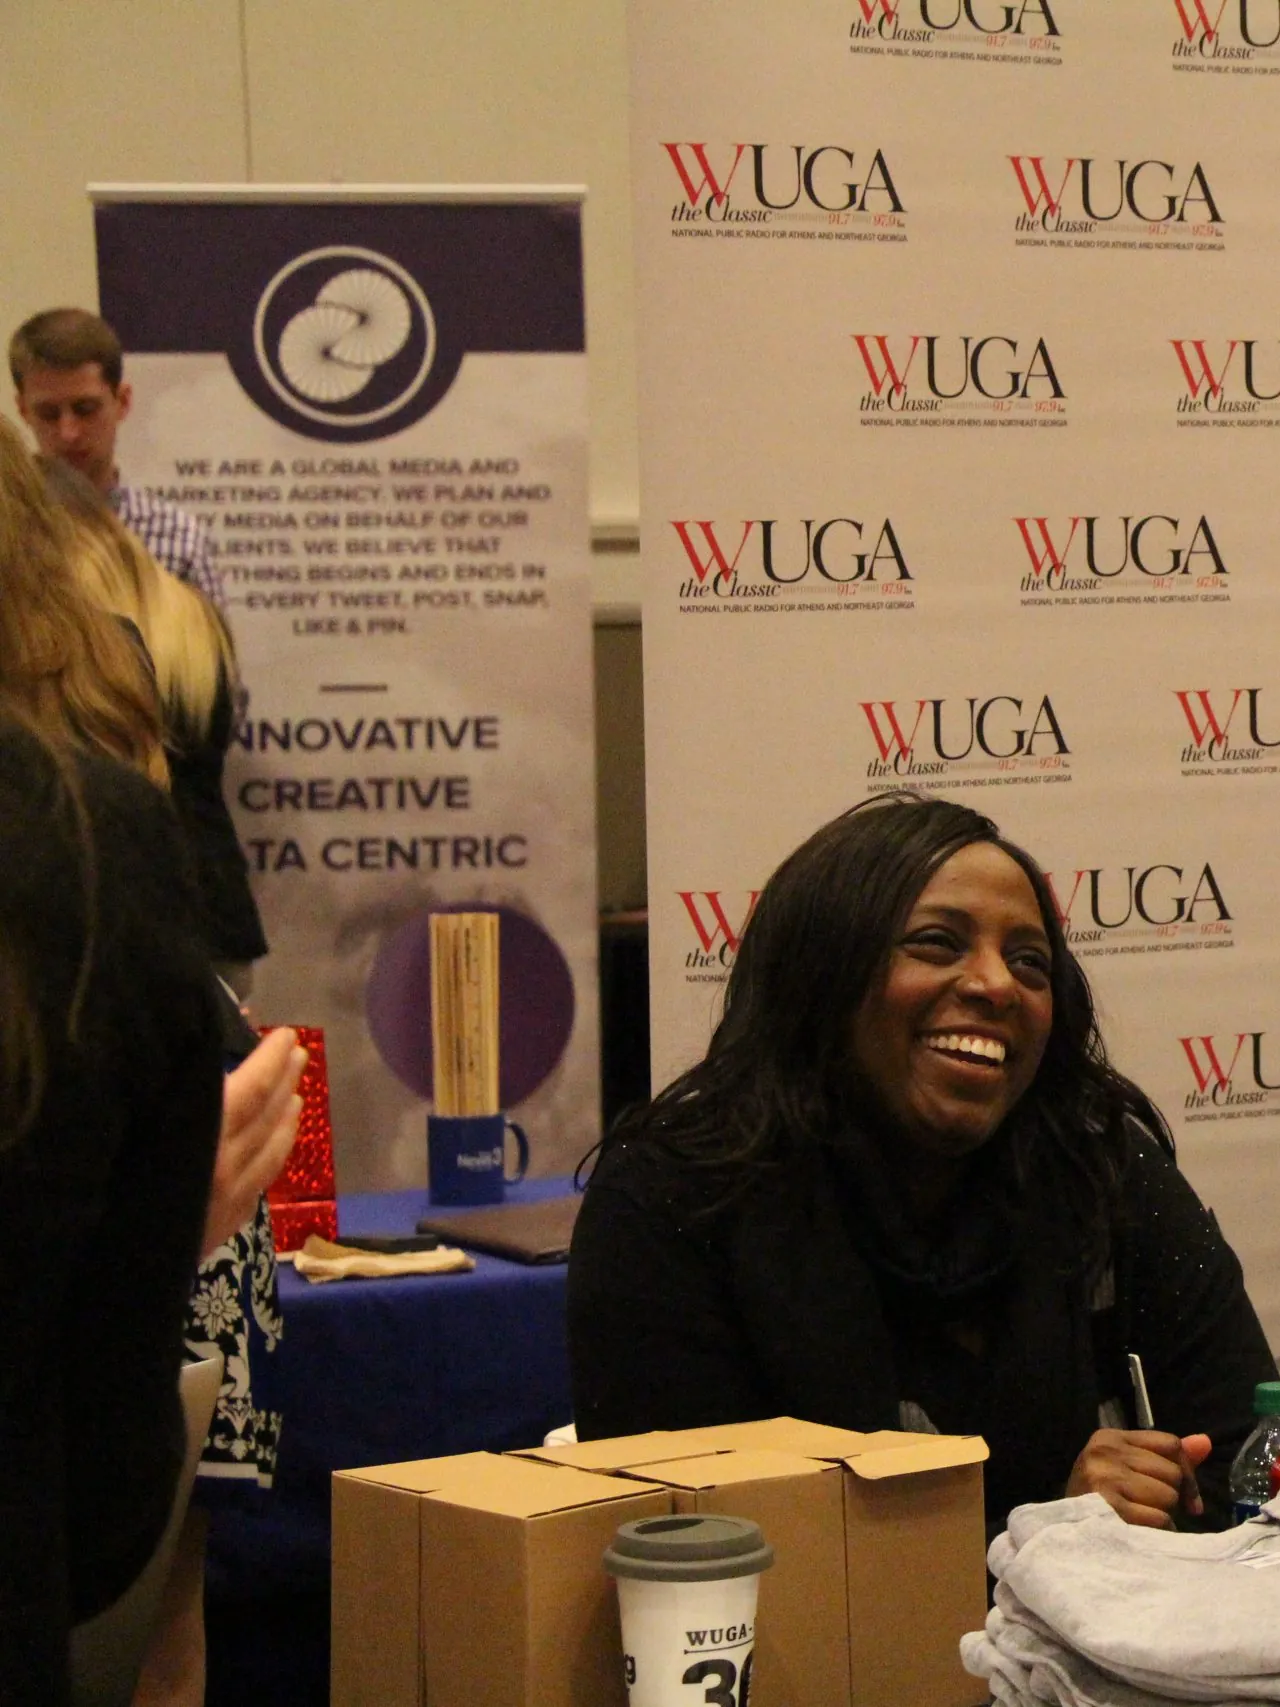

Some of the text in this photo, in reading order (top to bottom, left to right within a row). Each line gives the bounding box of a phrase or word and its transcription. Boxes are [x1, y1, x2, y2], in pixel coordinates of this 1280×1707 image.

[850, 18, 876, 39] the
[878, 12, 935, 43] Classic
[1172, 38, 1197, 57] the
[1199, 31, 1255, 60] Classic
[659, 143, 907, 213] WUGA
[1006, 156, 1225, 222] WUGA
[671, 202, 702, 221] the
[705, 193, 773, 222] Classic
[1015, 213, 1040, 232] the
[1042, 204, 1097, 233] Classic
[672, 228, 712, 237] NATIONAL
[716, 228, 743, 238] PUBLIC
[746, 229, 770, 238] RADIO
[788, 230, 817, 240] ATHENS
[835, 232, 876, 241] NORTHEAST
[877, 233, 908, 242] GEORGIA
[851, 335, 1068, 398] WUGA
[860, 391, 885, 412] the
[887, 383, 942, 412] Classic
[1177, 394, 1201, 413] the
[1204, 385, 1260, 414] Classic
[176, 459, 520, 477] WE ARE A GLOBAL MEDIA AND
[391, 484, 426, 502] WE
[434, 484, 494, 502] PLAN
[501, 484, 552, 502] AND
[224, 511, 298, 530] MEDIA
[304, 511, 341, 530] ON
[345, 511, 436, 530] BEHALF
[440, 511, 473, 530] OF
[478, 511, 530, 530] OUR
[304, 536, 338, 555] WE
[345, 536, 436, 555] BELIEVE
[444, 536, 502, 555] THAT
[671, 518, 914, 584] WUGA
[1013, 515, 1230, 577] WUGA
[307, 564, 392, 582] BEGINS
[398, 564, 450, 582] AND
[454, 564, 515, 582] ENDS
[522, 564, 547, 582] IN
[679, 578, 710, 598] the
[713, 568, 781, 598] Classic
[1020, 573, 1044, 592] the
[1046, 563, 1102, 591] Classic
[680, 604, 719, 613] NATIONAL
[724, 604, 751, 612] PUBLIC
[754, 604, 778, 612] RADIO
[798, 602, 825, 612] ATHENS
[844, 602, 884, 610] NORTHEAST
[885, 600, 914, 609] GEORGIA
[292, 617, 341, 636] LIKE
[345, 617, 361, 636] &
[230, 716, 499, 750] NNOVATIVE
[859, 694, 1072, 762] WUGA
[867, 758, 891, 778] the
[893, 748, 948, 776] Classic
[1181, 744, 1206, 762] the
[1208, 735, 1264, 762] Classic
[238, 775, 471, 813] CREATIVE
[248, 834, 528, 873] TA CENTRIC
[686, 948, 716, 967] the
[1185, 1089, 1210, 1109] the
[1212, 1080, 1268, 1108] Classic
